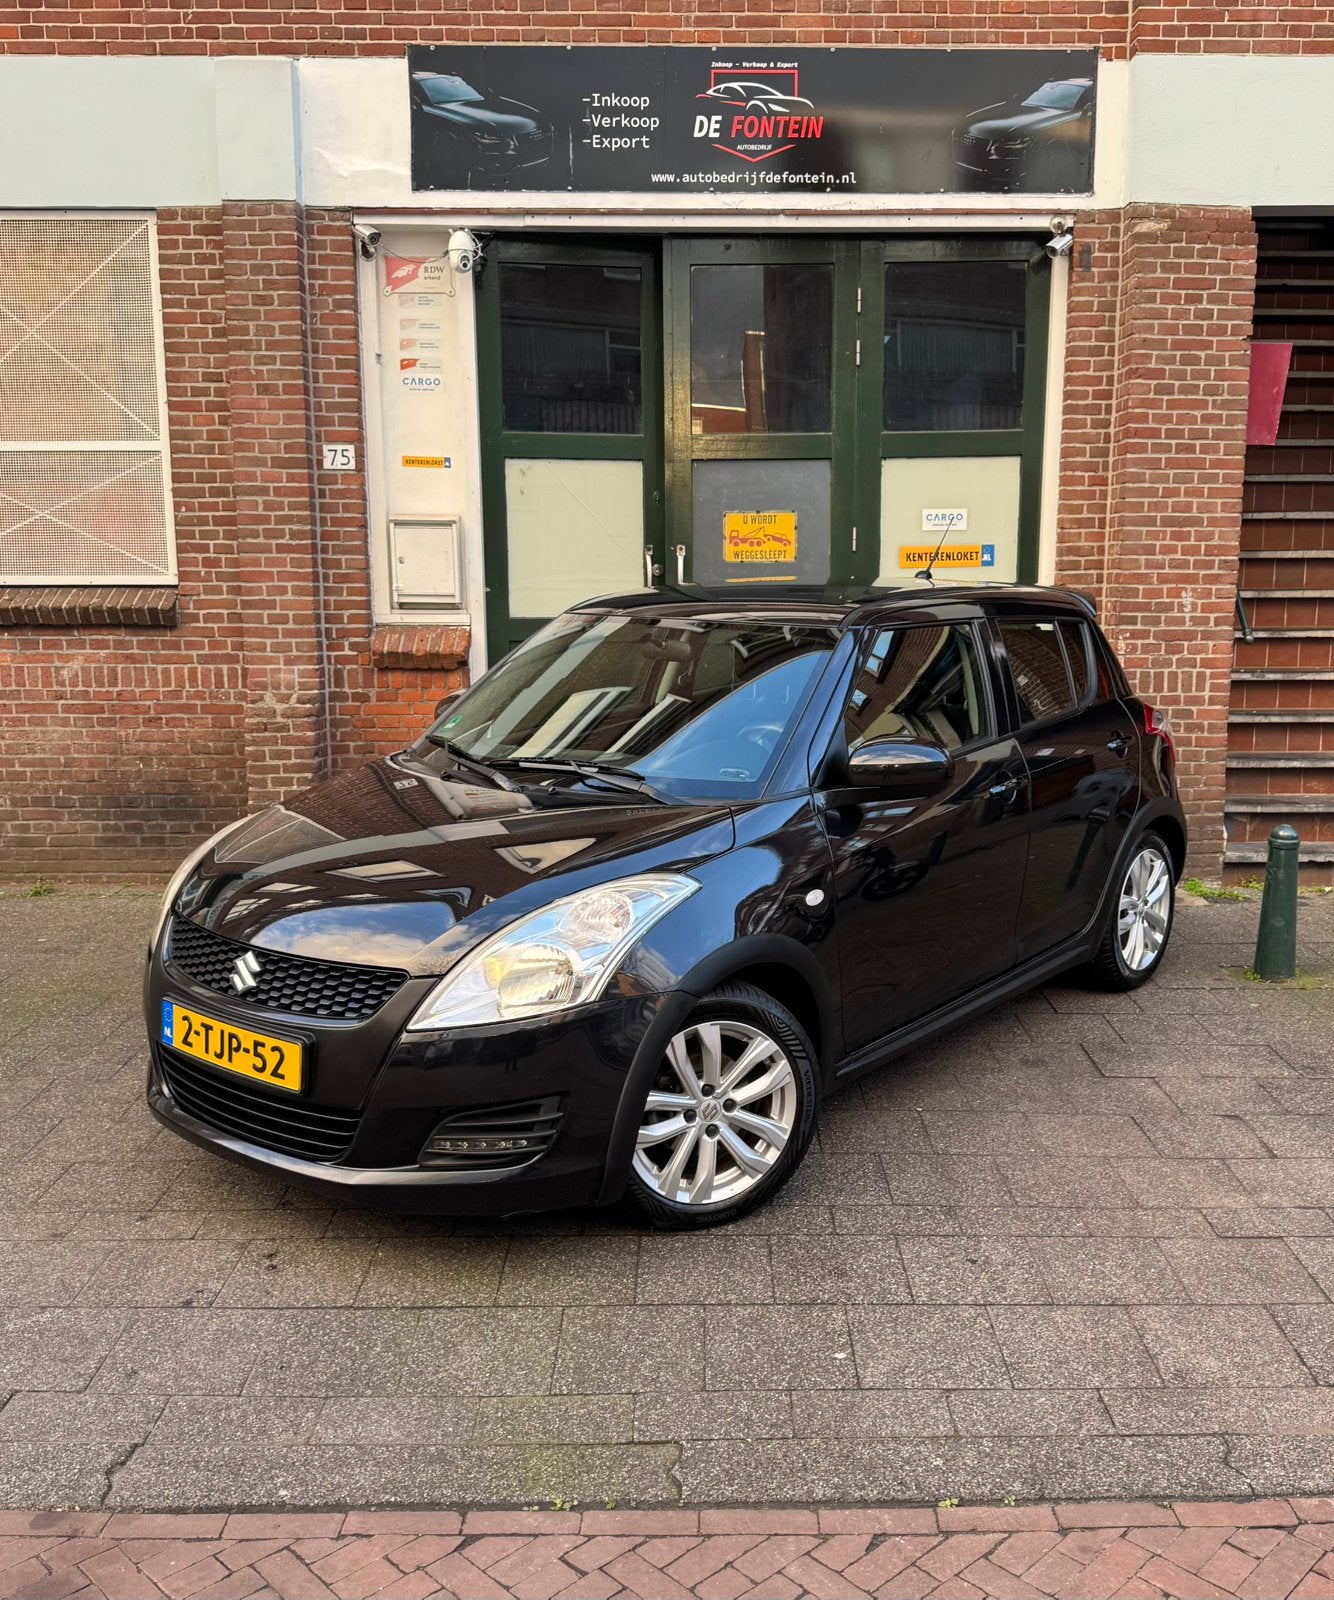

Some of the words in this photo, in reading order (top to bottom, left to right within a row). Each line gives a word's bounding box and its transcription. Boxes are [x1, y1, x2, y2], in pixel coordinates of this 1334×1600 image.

[582, 92, 650, 110] -Inkoop
[582, 113, 660, 131] -Verkoop
[693, 115, 722, 138] DE
[730, 115, 824, 138] FONTEIN
[582, 134, 650, 152] -Export
[650, 171, 857, 186] www.autobedrijfdefontein.nl
[423, 265, 445, 274] RDW
[402, 377, 441, 386] CARGO
[327, 448, 351, 466] 75
[742, 514, 749, 525] U
[750, 514, 778, 525] WORDT
[926, 513, 964, 522] CARGO
[733, 549, 788, 560] WEGGESLEEPT
[163, 1026, 173, 1038] NL
[181, 1014, 286, 1081] 2-TJP-52
